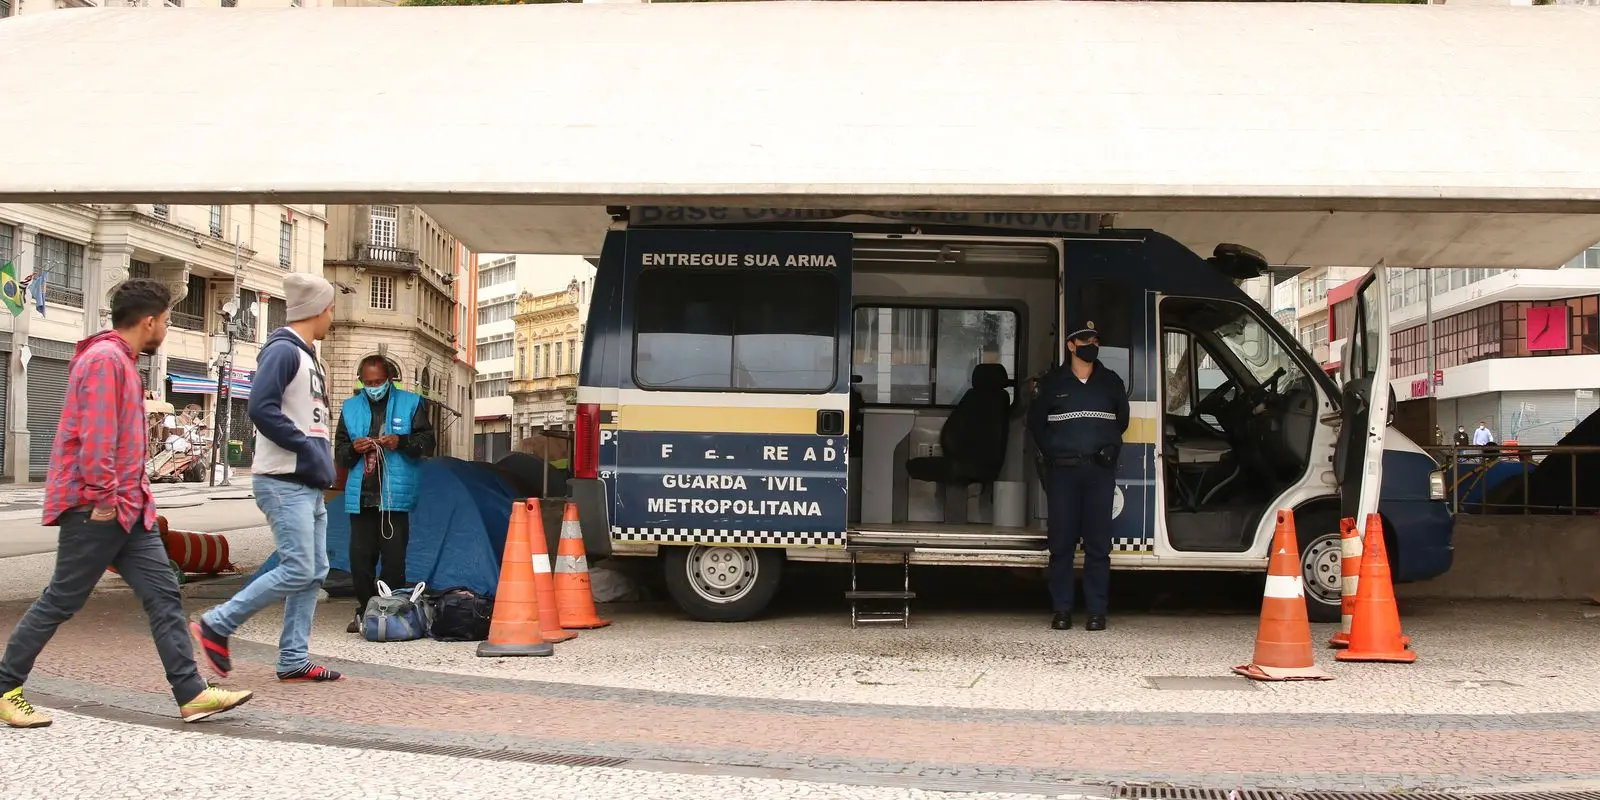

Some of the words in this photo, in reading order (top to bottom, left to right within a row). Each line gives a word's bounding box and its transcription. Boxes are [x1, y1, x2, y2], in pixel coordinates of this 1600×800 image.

[642, 253, 738, 267] ENTREGUE
[743, 253, 780, 267] SUA
[784, 254, 837, 267] ARMA
[662, 474, 747, 490] GUARDA
[761, 475, 808, 492] IVIL
[647, 498, 823, 517] METROPOLITANA
